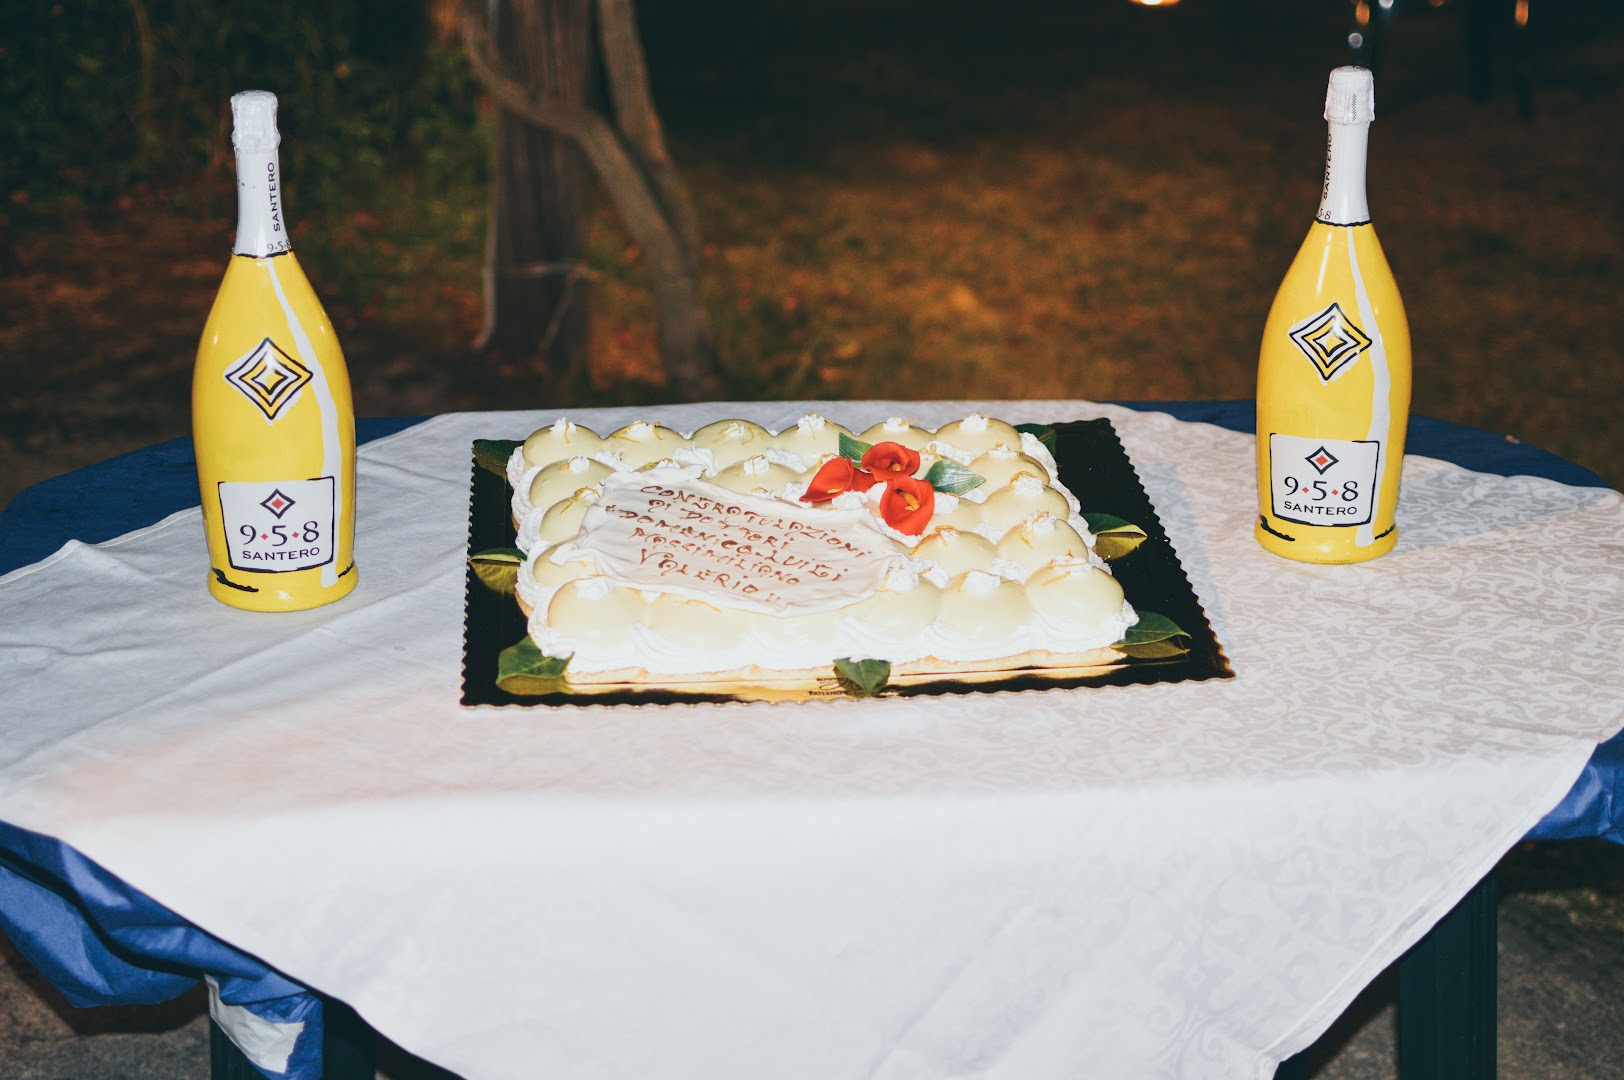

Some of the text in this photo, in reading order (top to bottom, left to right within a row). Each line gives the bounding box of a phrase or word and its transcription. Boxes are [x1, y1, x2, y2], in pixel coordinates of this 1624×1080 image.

[1323, 133, 1333, 200] SANTERO
[267, 162, 281, 232] SANTERO
[1284, 500, 1358, 516] SANTERO
[242, 547, 320, 561] SANTERO
